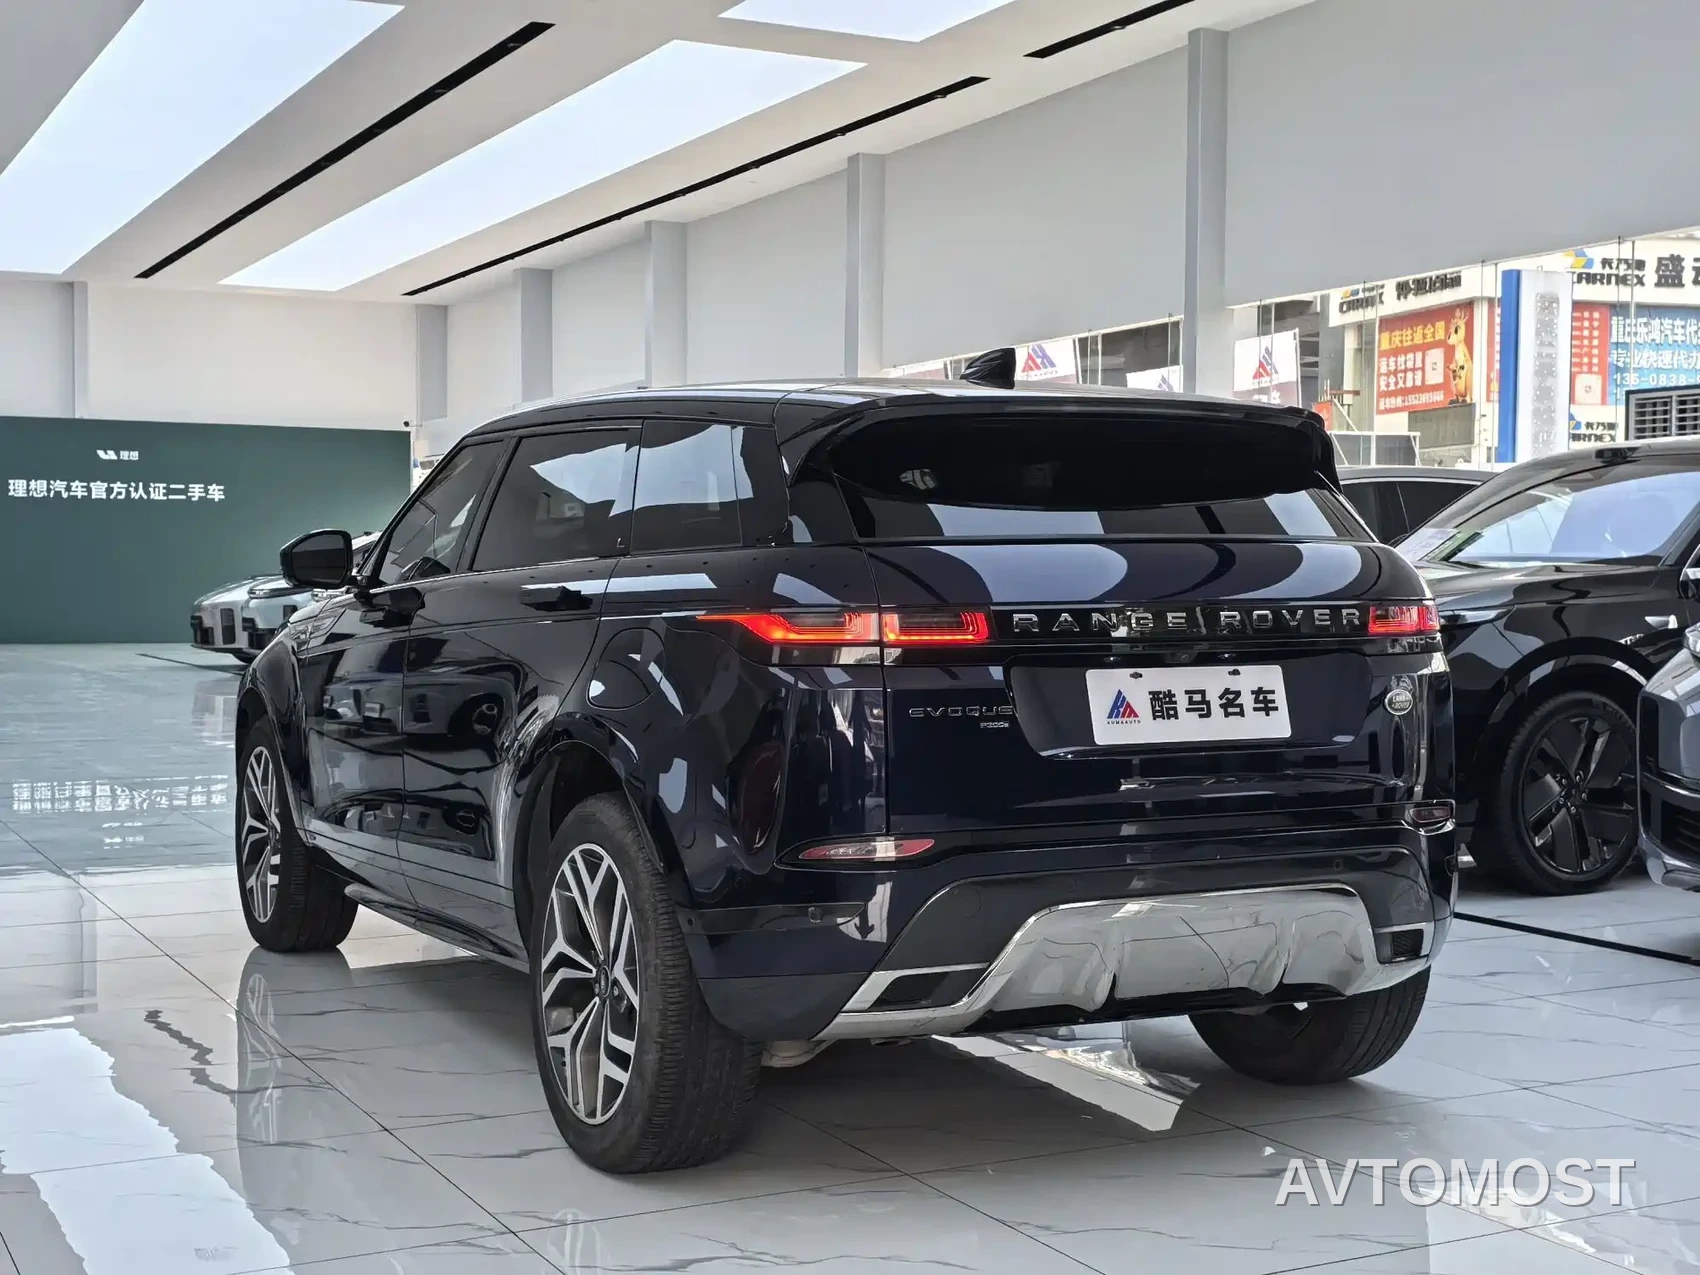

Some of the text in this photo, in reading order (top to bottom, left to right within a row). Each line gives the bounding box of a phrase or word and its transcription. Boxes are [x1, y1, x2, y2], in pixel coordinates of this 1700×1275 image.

[1654, 253, 1700, 288] 盛
[119, 450, 140, 461] 理想
[8, 479, 226, 502] 理想汽车官方认证二手车
[1012, 608, 1360, 633] RANGE ROVER
[908, 705, 1014, 718] EVOQUE
[1148, 686, 1279, 721] 酷马名车
